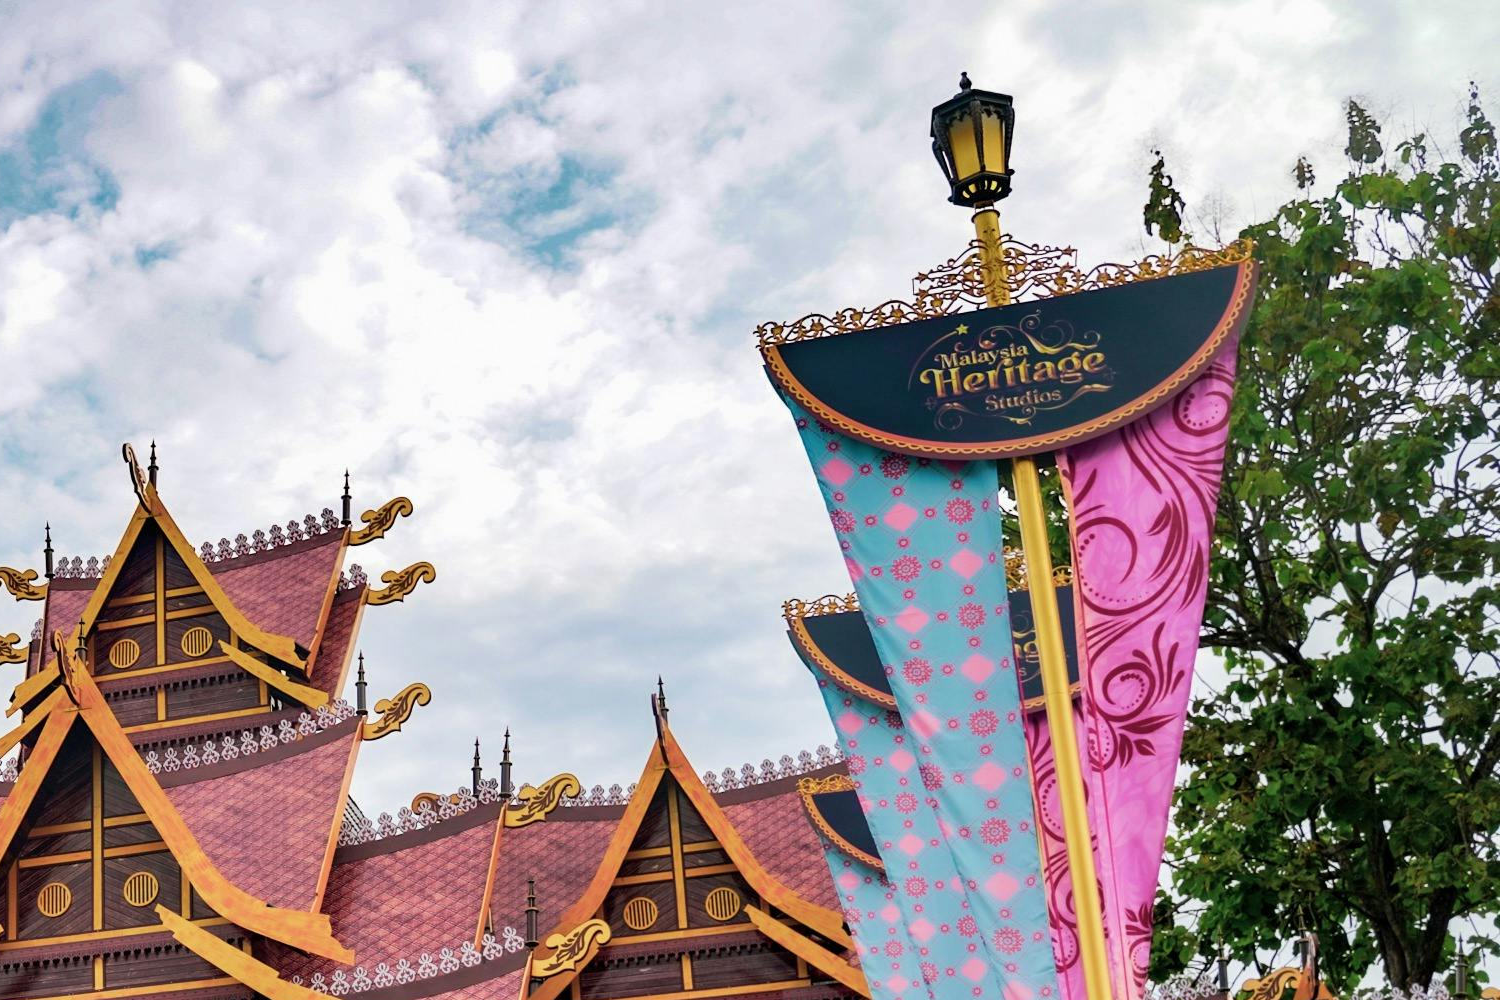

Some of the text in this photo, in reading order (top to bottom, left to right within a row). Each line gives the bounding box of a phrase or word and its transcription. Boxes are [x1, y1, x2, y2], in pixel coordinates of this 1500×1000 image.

[934, 343, 1030, 369] Malaysia
[920, 351, 1106, 398] Heritage
[985, 388, 1062, 412] Studios
